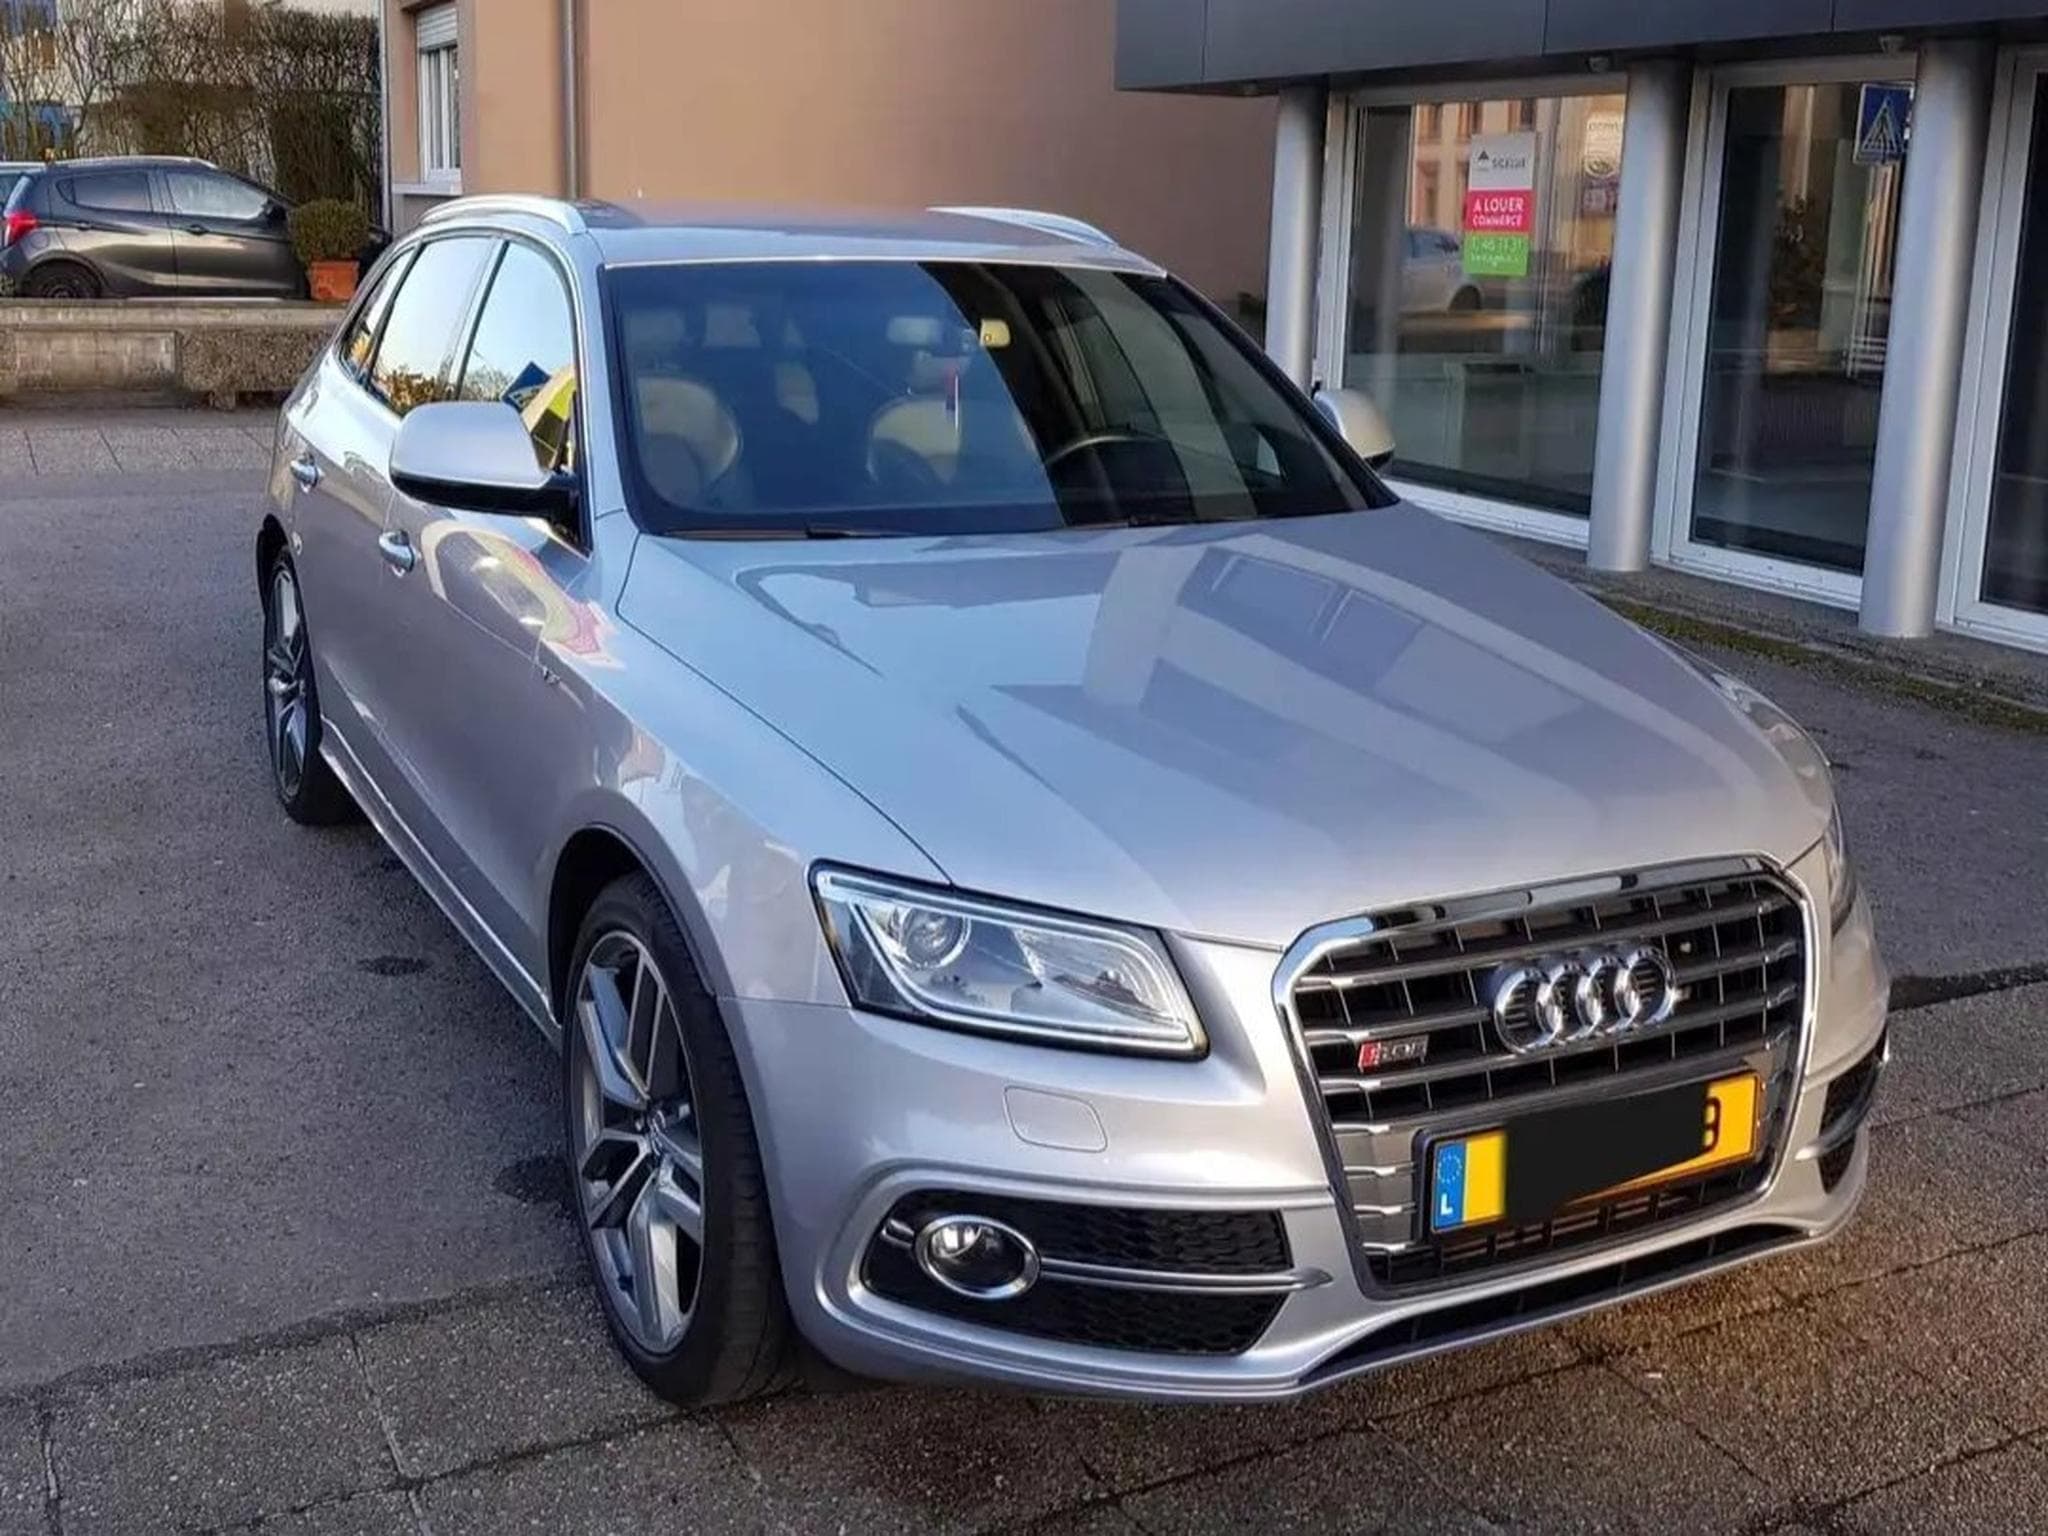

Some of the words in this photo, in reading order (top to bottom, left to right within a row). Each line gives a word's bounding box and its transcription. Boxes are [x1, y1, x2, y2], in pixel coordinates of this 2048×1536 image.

[1473, 199, 1482, 212] A
[1484, 197, 1524, 212] LOUER
[1472, 214, 1522, 227] COMMERCE
[1441, 1193, 1453, 1216] L
